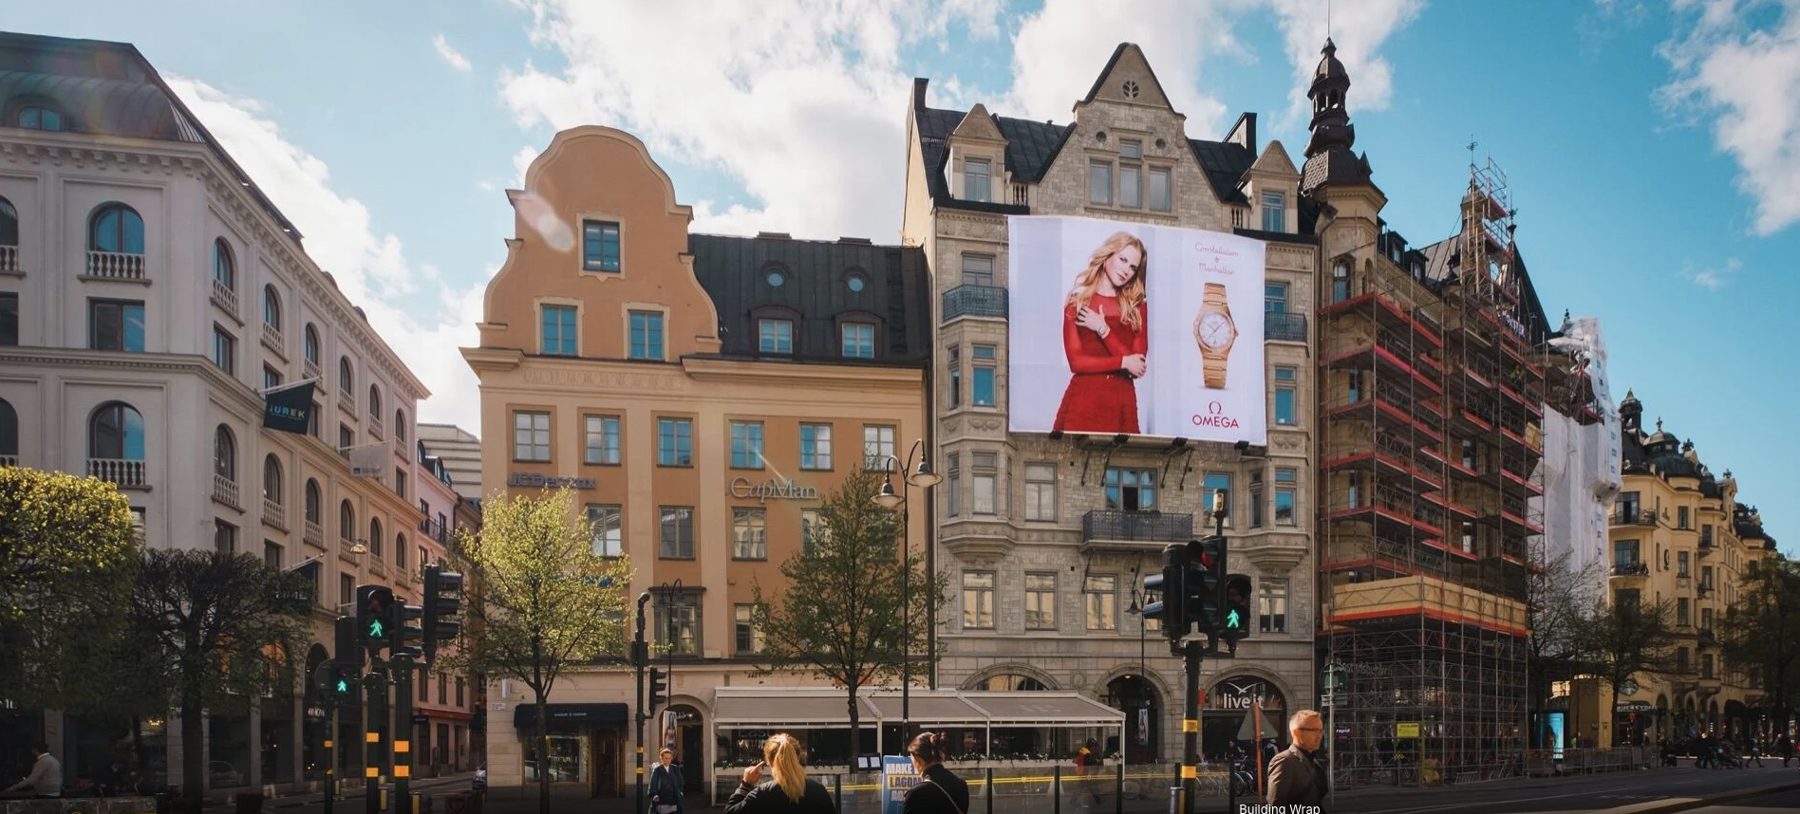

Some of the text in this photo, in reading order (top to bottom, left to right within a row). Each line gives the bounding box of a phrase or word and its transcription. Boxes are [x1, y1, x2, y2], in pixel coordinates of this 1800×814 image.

[1192, 414, 1240, 429] OMEGA
[731, 476, 818, 504] CapMan
[886, 763, 913, 775] MAKE
